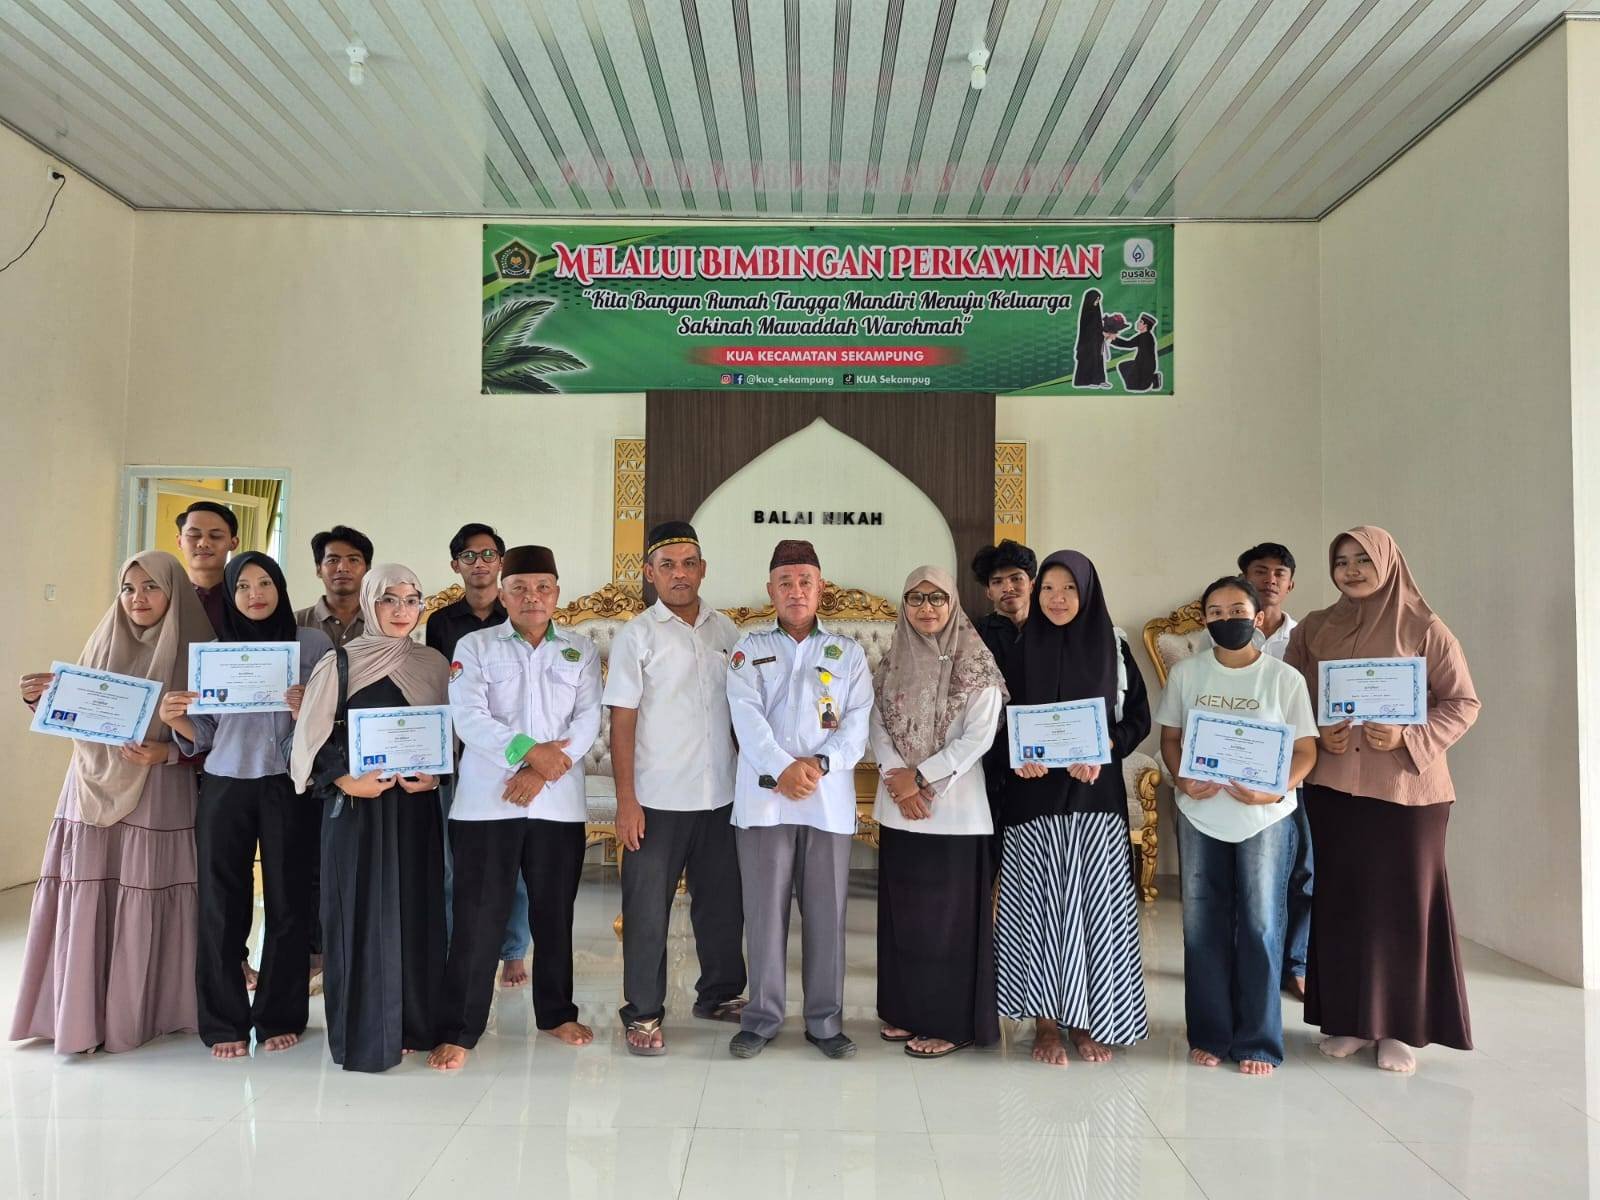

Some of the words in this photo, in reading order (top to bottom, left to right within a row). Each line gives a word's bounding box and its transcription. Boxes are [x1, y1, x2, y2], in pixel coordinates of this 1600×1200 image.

[554, 243, 695, 284] MELALUI
[700, 245, 886, 280] BIMBINGAN
[889, 244, 1103, 279] PERKAWINAN
[1121, 269, 1156, 279] pusaka
[583, 290, 628, 309] "Kita
[632, 292, 702, 314] Bangun
[706, 291, 768, 310] Rumah
[773, 291, 841, 314] Tangga
[845, 291, 915, 310] Mandiri
[920, 291, 984, 313] Menuju
[989, 290, 1071, 312] Keluarga
[678, 317, 753, 336] Sakinah
[757, 316, 858, 336] Mawaddah
[863, 316, 972, 335] Warohmah"
[725, 350, 754, 362] KUA
[757, 350, 836, 362] KECAMATAN
[841, 350, 924, 362] SEKAMPUNG
[746, 374, 834, 386] @kua_sekampung
[856, 375, 877, 384] KUA
[880, 375, 931, 386] Sekampug
[754, 510, 813, 524] BALAI
[822, 511, 882, 525] NIKAH
[1195, 695, 1260, 710] KENZO
